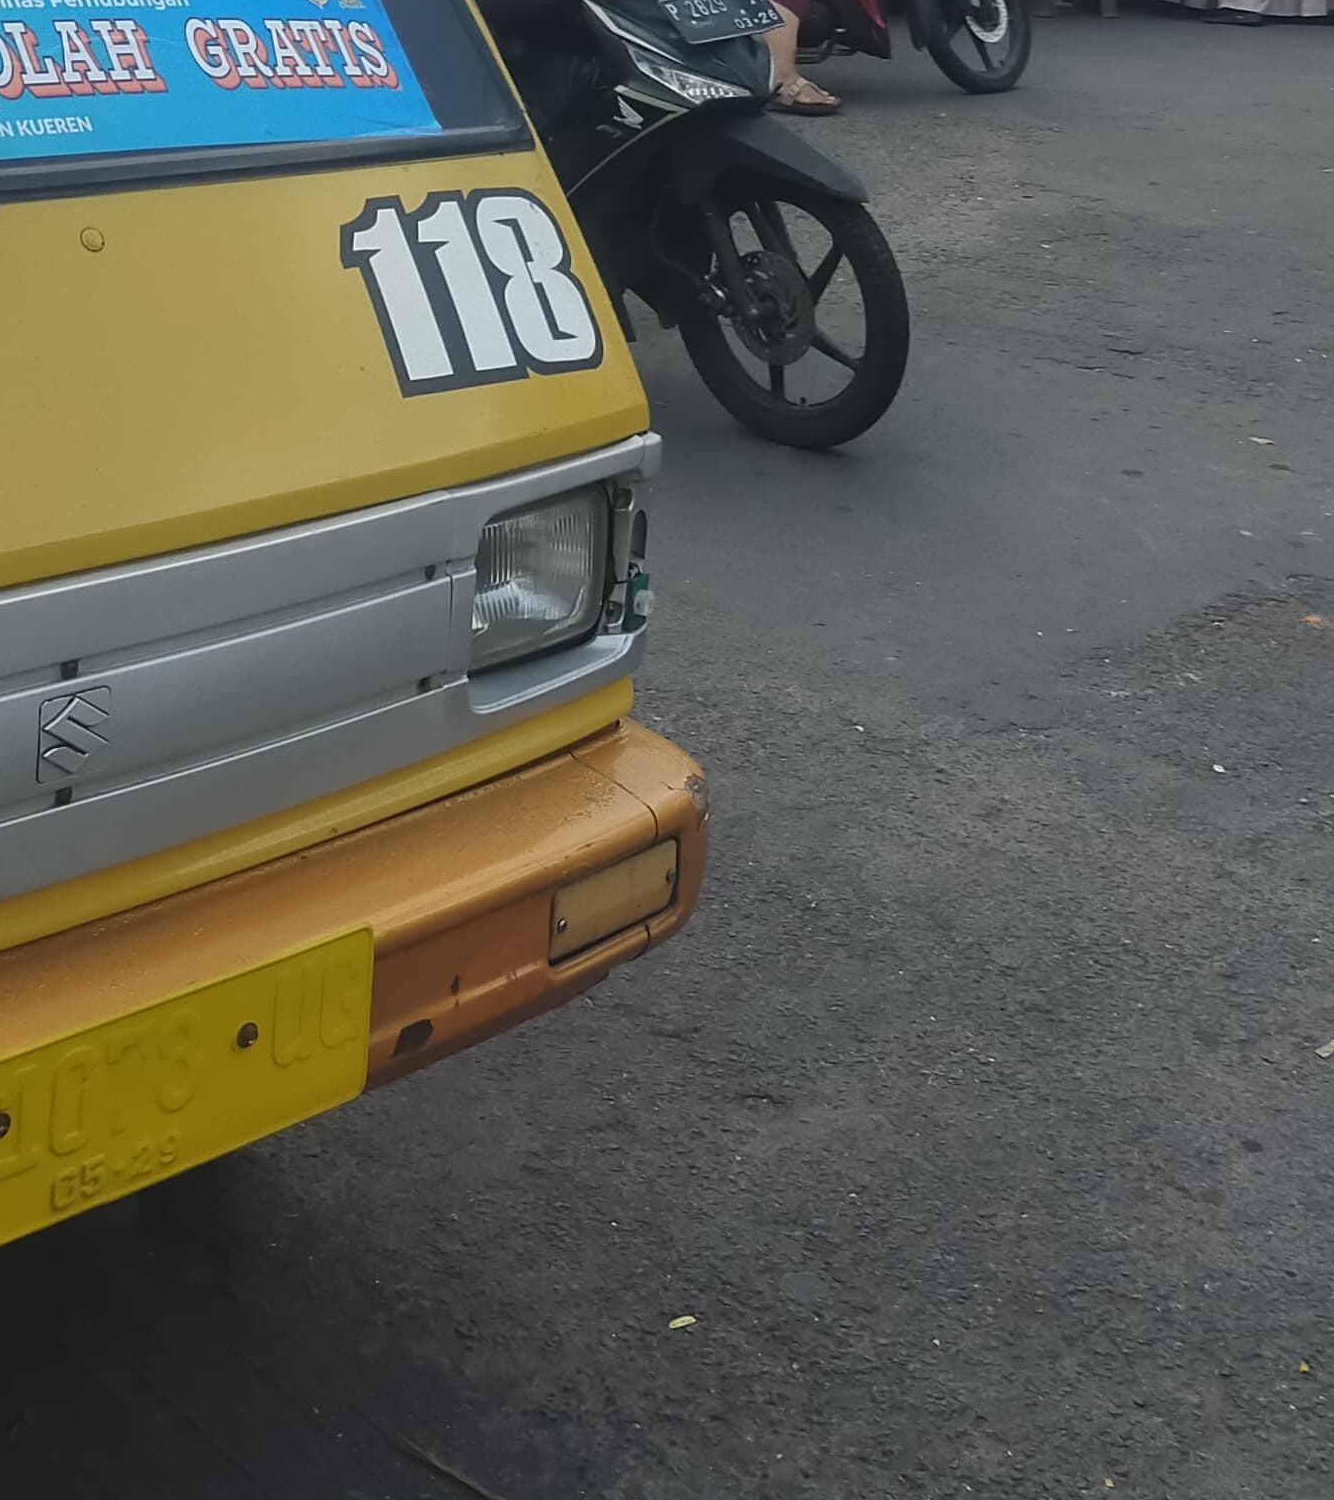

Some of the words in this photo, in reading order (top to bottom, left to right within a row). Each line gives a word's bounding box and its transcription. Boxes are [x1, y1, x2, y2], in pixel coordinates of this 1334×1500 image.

[665, 3, 680, 21] P
[184, 16, 399, 86] GRATIS
[16, 116, 94, 137] KUEREN
[347, 194, 599, 388] 118
